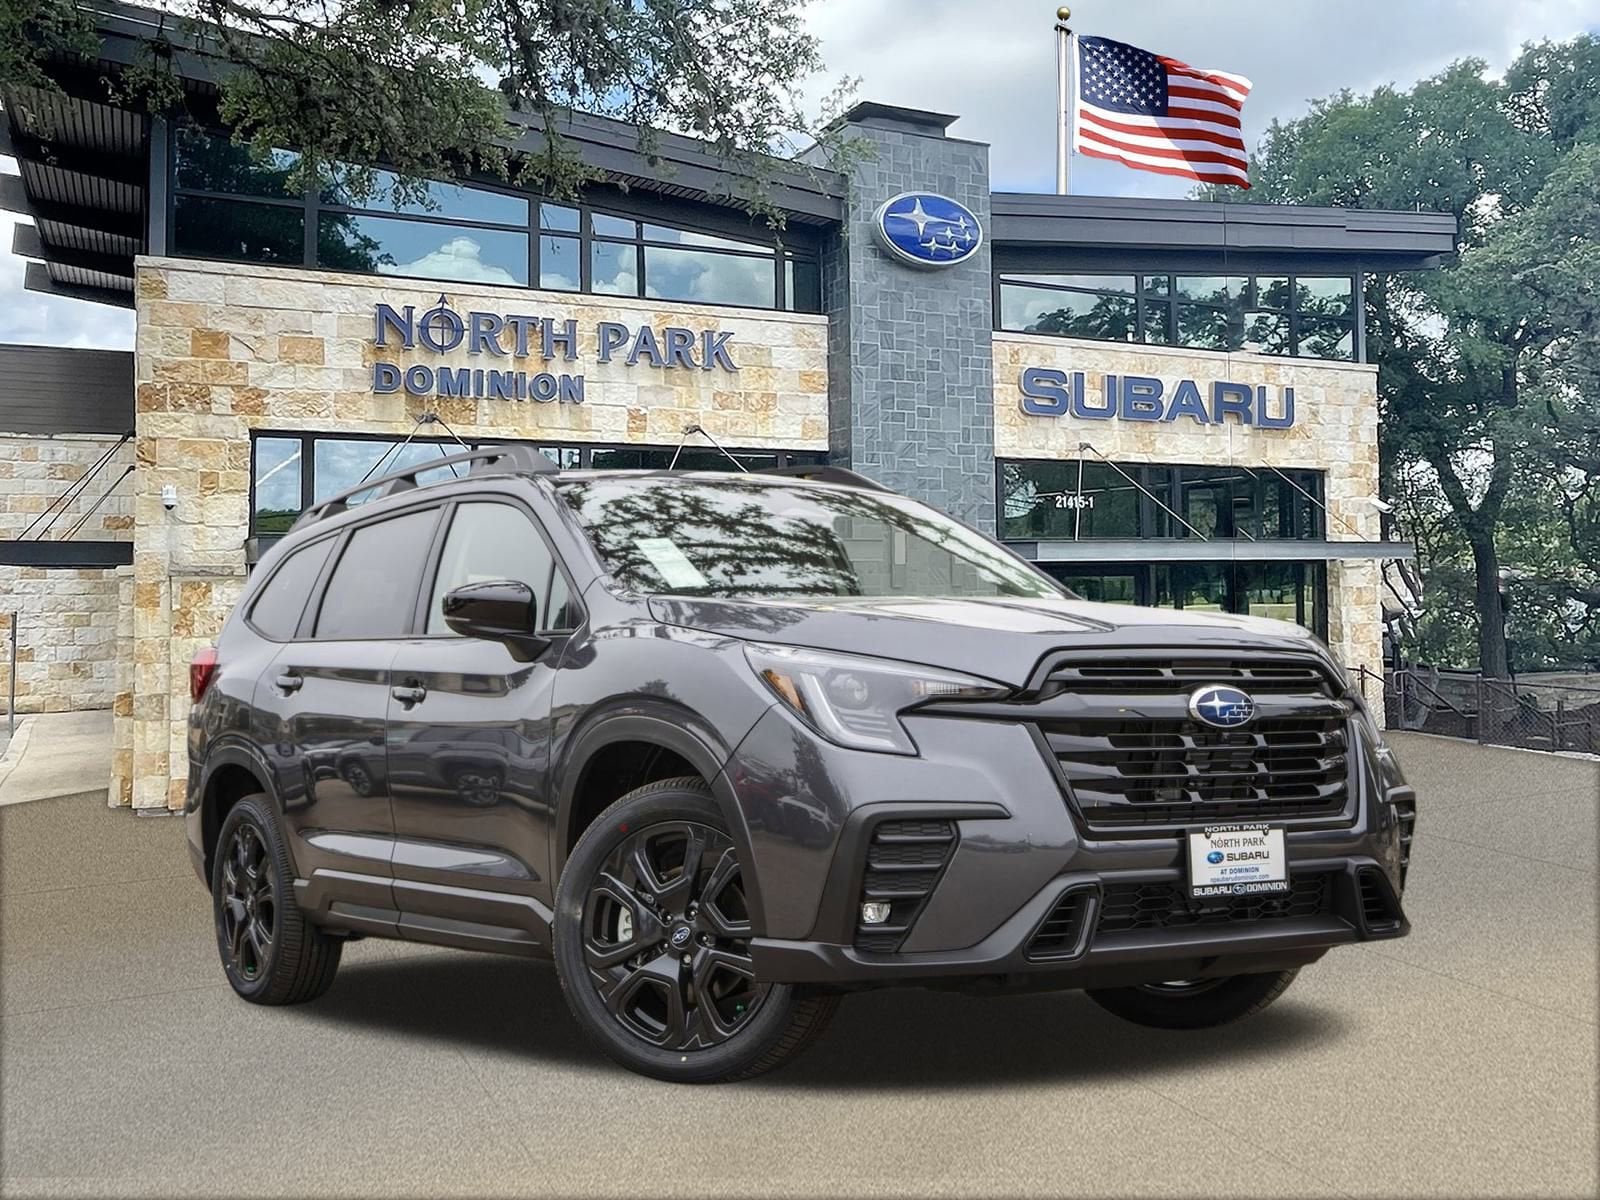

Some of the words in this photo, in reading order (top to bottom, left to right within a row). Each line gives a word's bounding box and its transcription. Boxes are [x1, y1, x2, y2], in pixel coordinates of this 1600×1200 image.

[374, 295, 579, 361] NORTH
[598, 320, 742, 372] PARK
[373, 361, 585, 404] DOMINION
[1018, 367, 1295, 429] SUBARU
[1204, 825, 1240, 833] NORTH
[1243, 823, 1270, 831] PARK
[1210, 837, 1240, 848] NORTH
[1242, 836, 1266, 846] PARK
[1226, 851, 1270, 861] SUBARU
[1229, 866, 1260, 874] DOMINION
[1193, 886, 1232, 897] SUBARU
[1246, 881, 1288, 892] DOMINION
